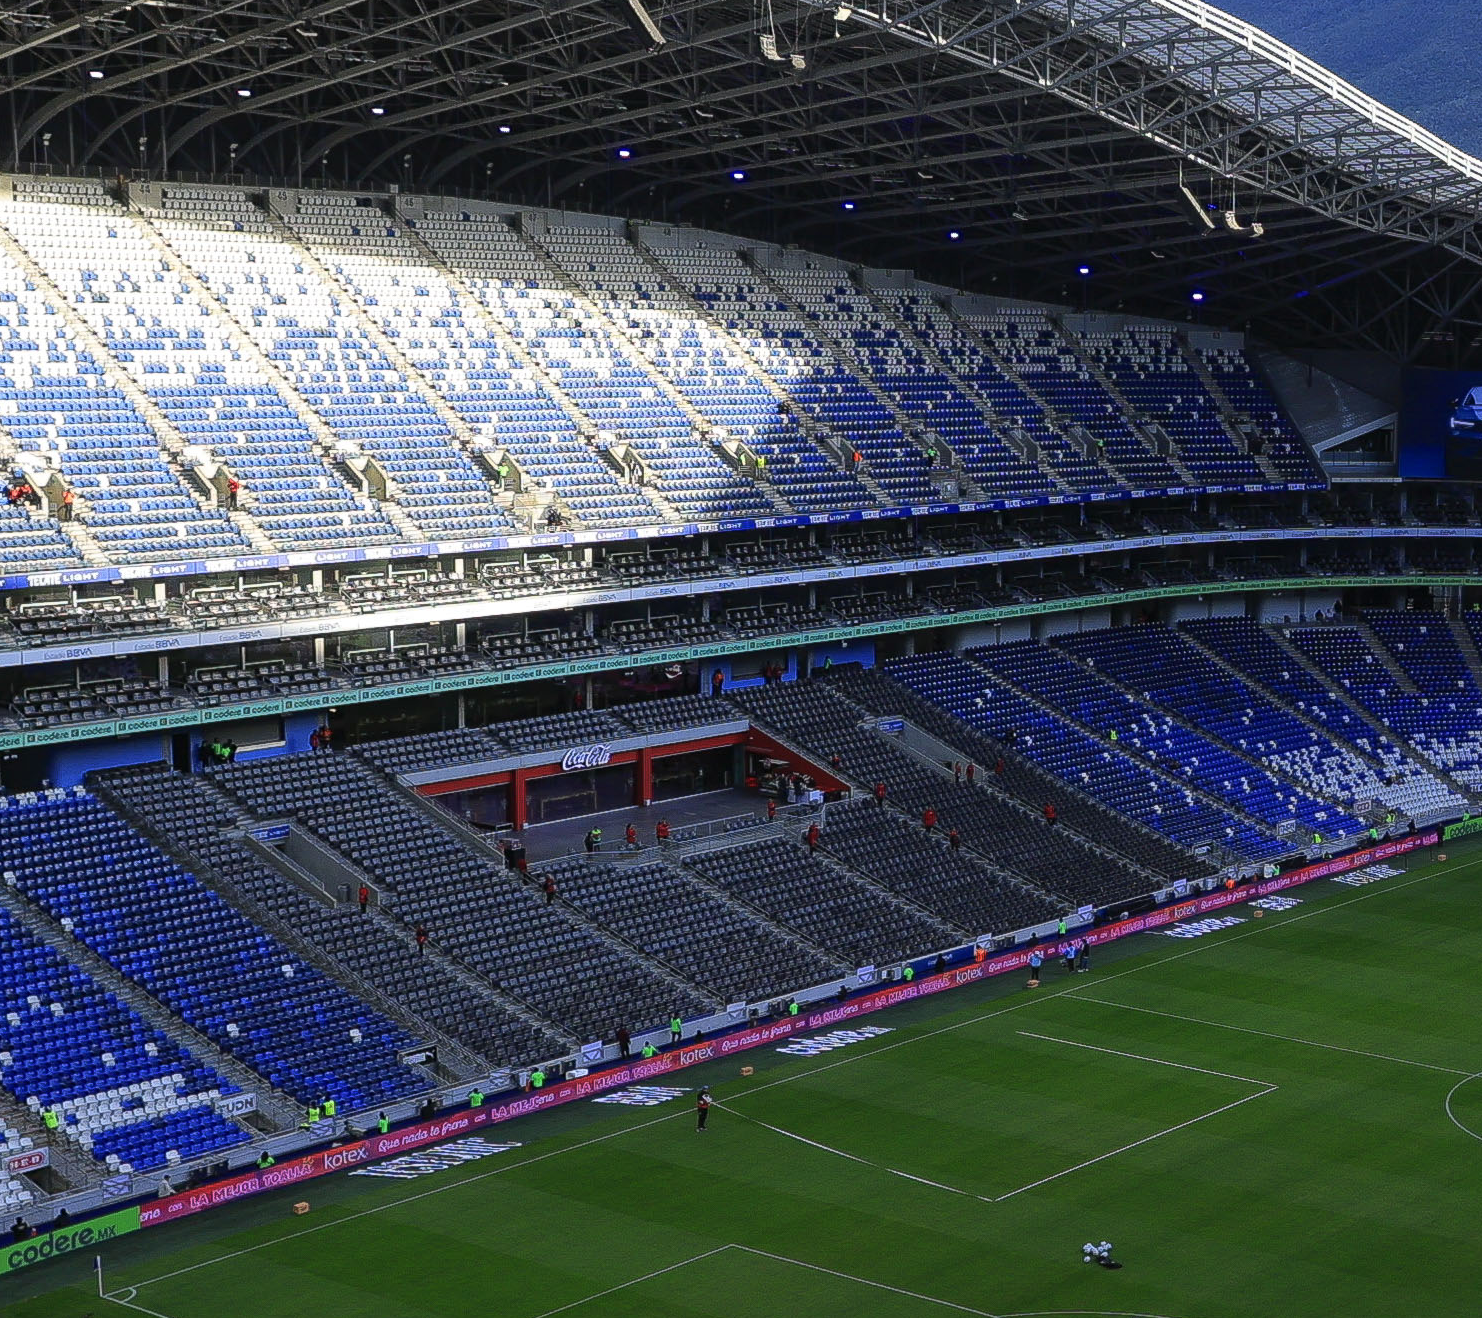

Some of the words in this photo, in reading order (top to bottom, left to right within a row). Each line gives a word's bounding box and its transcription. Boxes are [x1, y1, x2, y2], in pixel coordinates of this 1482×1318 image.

[153, 564, 188, 575] LIGHT
[236, 558, 270, 568] LIGHT
[62, 571, 99, 582] LIGHT
[155, 638, 180, 649] BBVA
[66, 647, 93, 658] BBVA
[955, 966, 983, 984] kotex
[680, 1044, 714, 1065] kotex
[721, 1038, 738, 1052] Que
[324, 1146, 367, 1170] kotex
[378, 1137, 401, 1153] Que
[401, 1130, 428, 1149] nada
[491, 1105, 507, 1120] LA
[189, 1194, 209, 1209] LA
[212, 1177, 260, 1203] MEJOR
[262, 1163, 315, 1187] TOALLA
[8, 1225, 116, 1269] codere.MX
